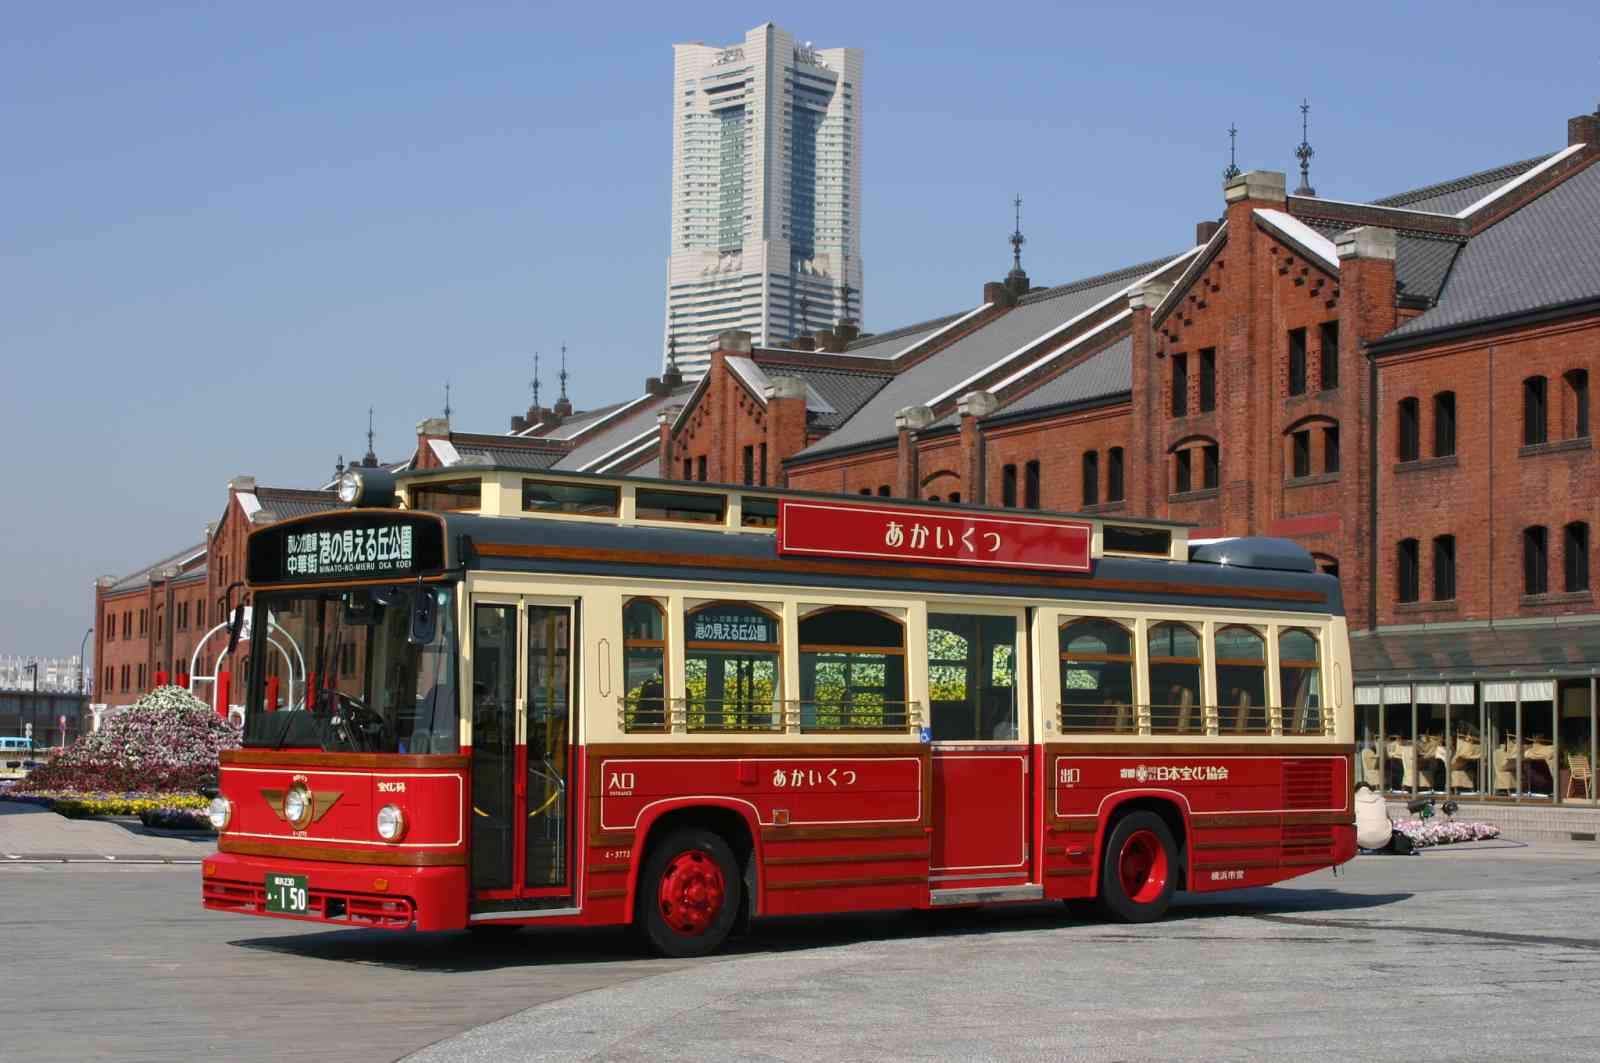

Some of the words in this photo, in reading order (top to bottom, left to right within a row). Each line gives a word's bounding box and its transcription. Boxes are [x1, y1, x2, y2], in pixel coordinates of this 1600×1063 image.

[319, 525, 412, 564] 港の見える丘公園
[885, 521, 1001, 552] あかいくつ
[608, 772, 634, 789] 入口
[772, 768, 857, 788] あかいくつ
[1060, 768, 1080, 783] 出口
